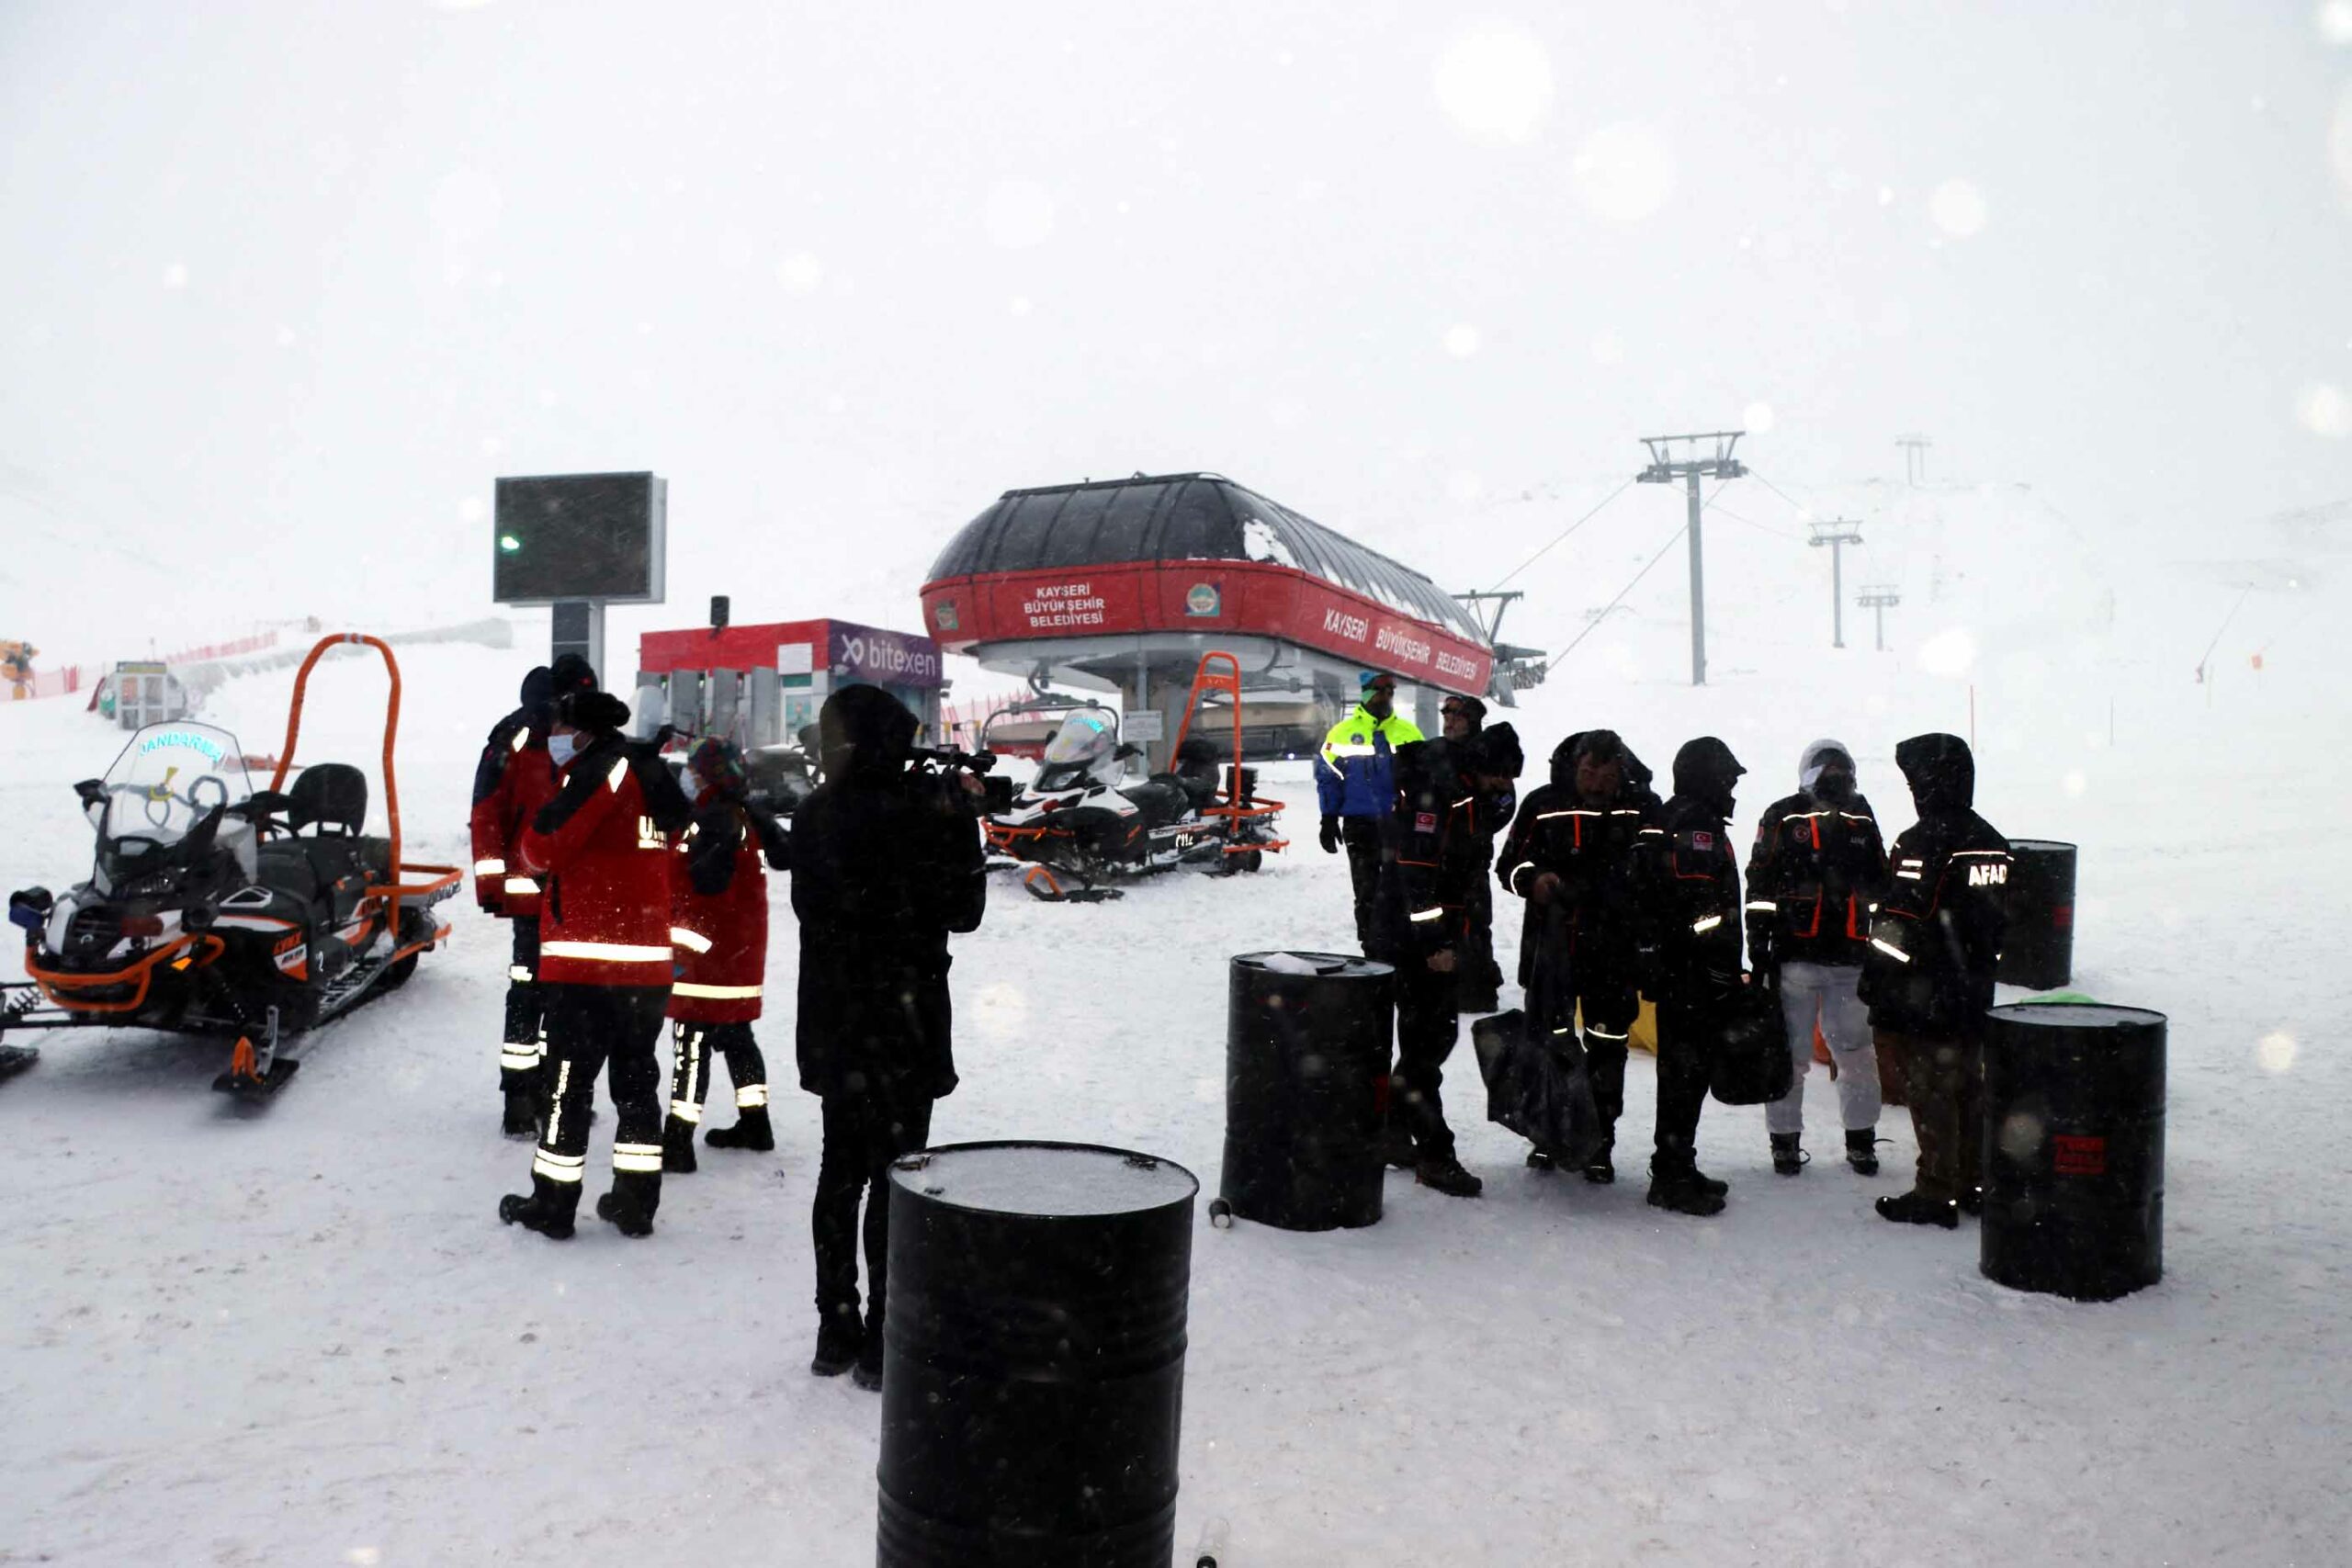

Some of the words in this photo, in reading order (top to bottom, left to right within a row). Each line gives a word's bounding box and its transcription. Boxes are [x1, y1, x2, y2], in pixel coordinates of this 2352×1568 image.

[1036, 582, 1091, 598] KAYSERİ
[1023, 597, 1105, 614] BÜYÜKŞEHİR
[1030, 611, 1103, 627] BELEDİYESİ
[1323, 608, 1370, 643] KAYSERİ
[1375, 626, 1431, 665] BÜYÜKŞEHİR
[1435, 650, 1478, 682] BELEDİYESİ
[869, 637, 936, 677] bitexen
[1968, 864, 2007, 886] AFAD
